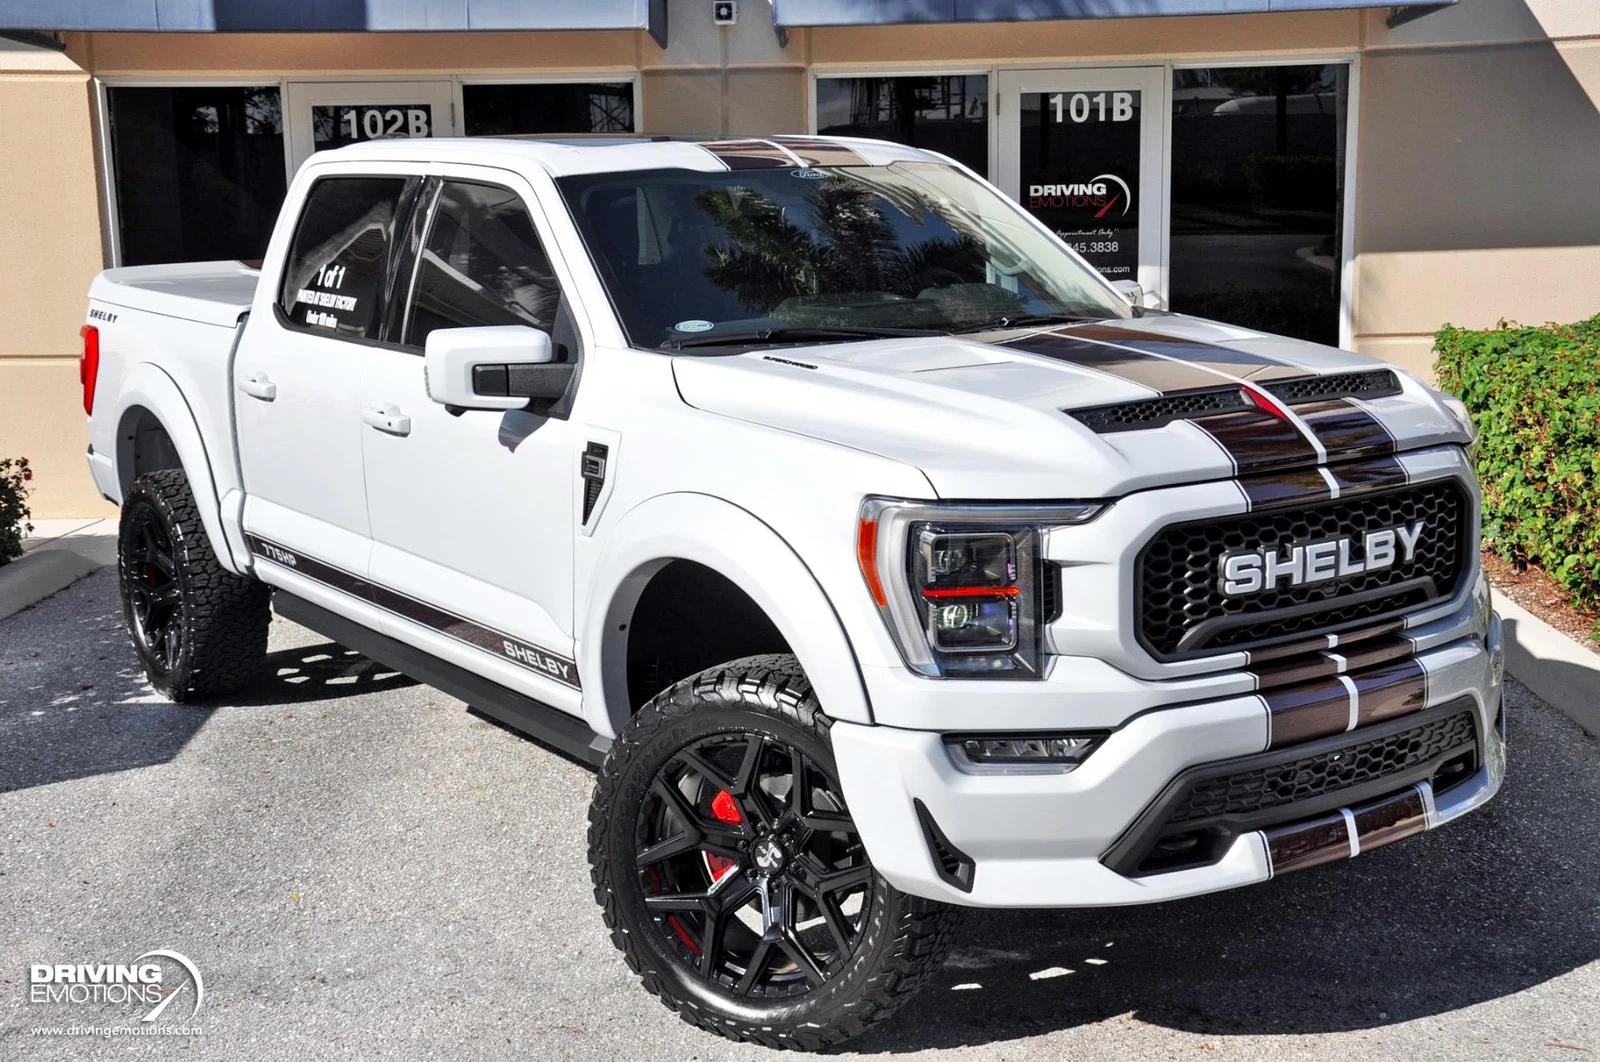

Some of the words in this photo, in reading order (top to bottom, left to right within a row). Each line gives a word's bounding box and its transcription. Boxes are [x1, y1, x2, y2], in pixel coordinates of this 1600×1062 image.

[1049, 92, 1133, 123] 101B
[343, 109, 429, 139] 102B
[1029, 183, 1107, 197] DRIVING
[1029, 196, 1107, 208] EMOTIONS
[317, 264, 327, 286] 1
[324, 265, 339, 288] of
[336, 266, 346, 289] 1
[90, 309, 118, 324] SHELBY
[261, 542, 297, 567] 775HP
[1220, 521, 1424, 595] SHELBY
[503, 640, 568, 679] SHELBY
